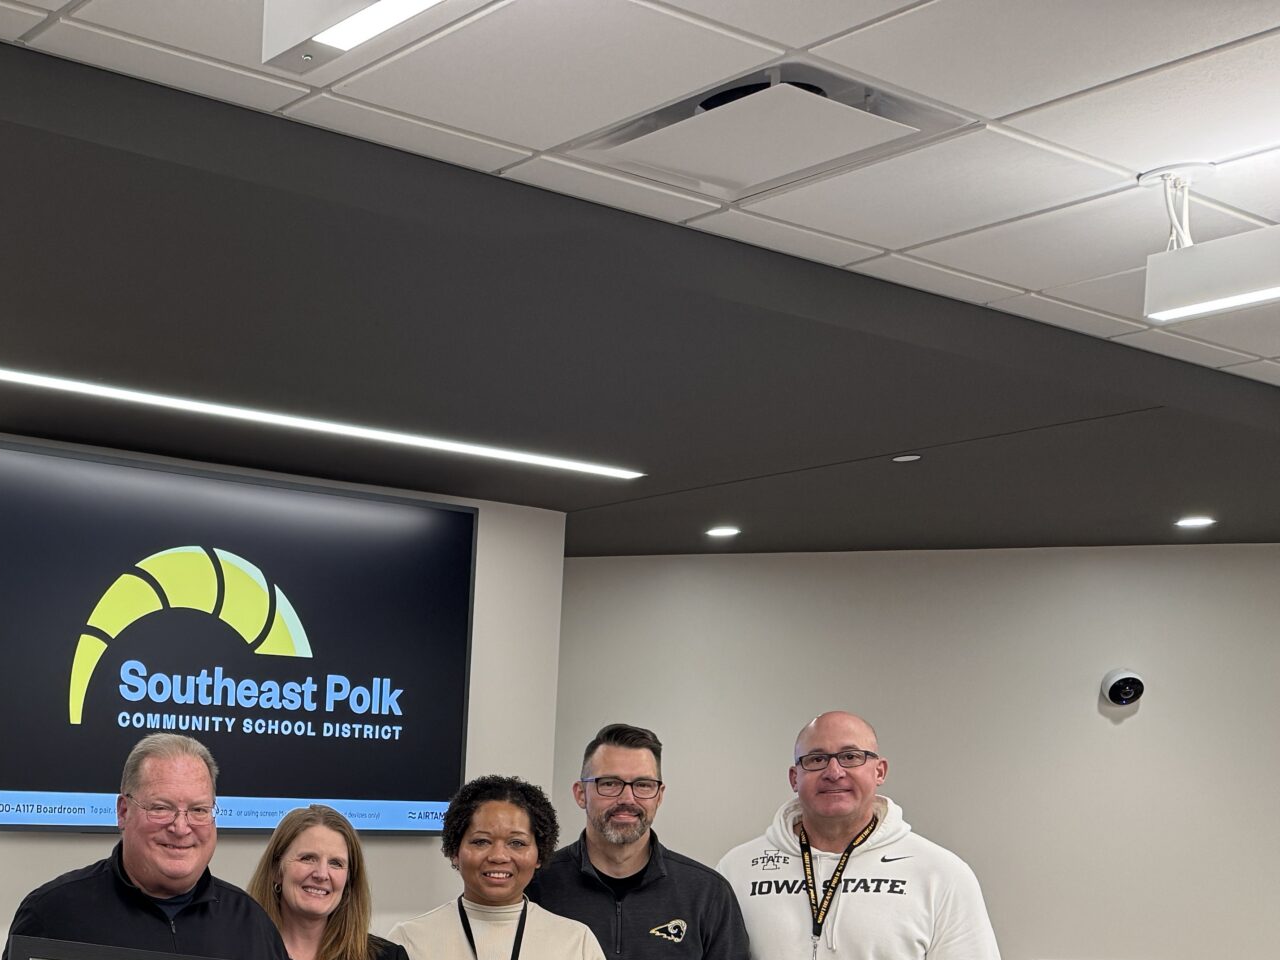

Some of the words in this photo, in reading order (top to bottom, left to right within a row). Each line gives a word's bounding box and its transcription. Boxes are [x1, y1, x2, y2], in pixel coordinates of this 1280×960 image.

[119, 660, 317, 711] Southeast
[325, 674, 404, 716] Polk
[118, 711, 236, 733] COMMUNITY
[242, 718, 316, 736] SCHOOL
[322, 722, 403, 740] DISTRICT
[36, 804, 86, 814] Boardroom
[243, 810, 259, 818] using
[751, 855, 790, 867] STATE
[750, 879, 810, 896] IOWA
